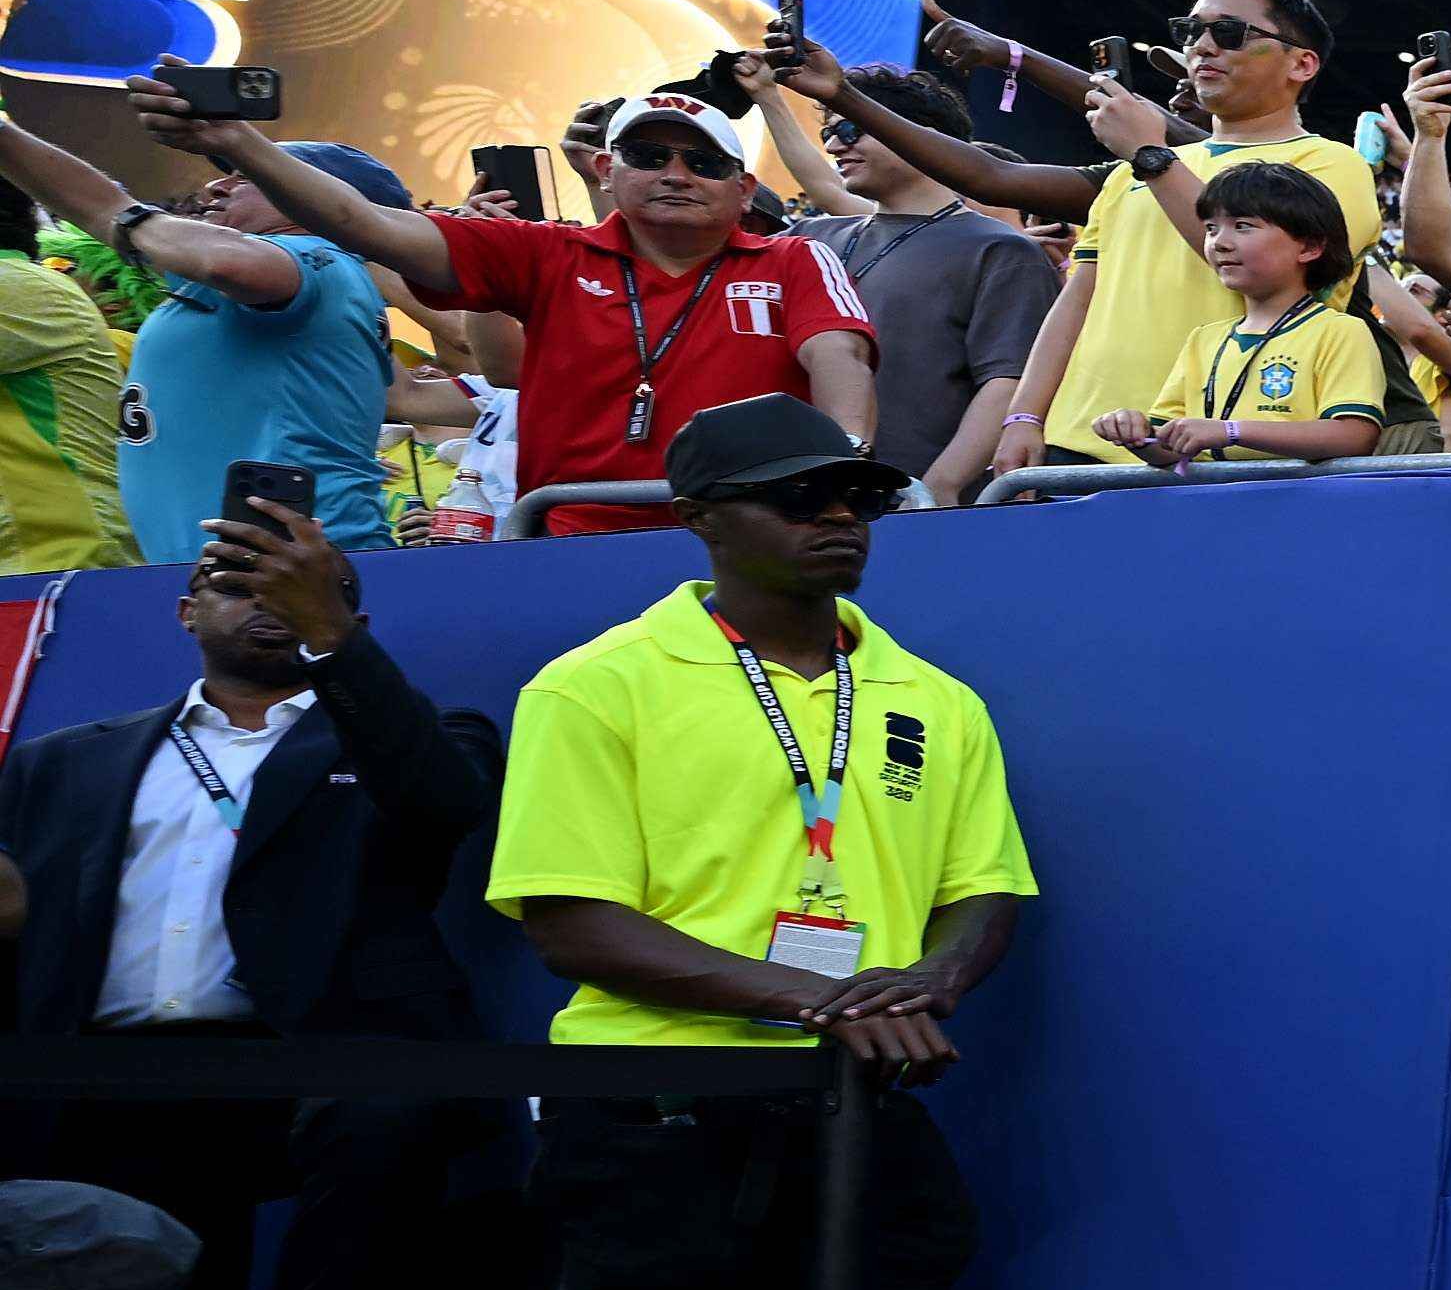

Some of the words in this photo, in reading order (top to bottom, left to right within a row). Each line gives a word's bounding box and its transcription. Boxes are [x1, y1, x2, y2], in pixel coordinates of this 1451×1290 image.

[732, 283, 784, 300] FPF
[755, 683, 776, 707] CUP
[837, 673, 852, 708] WORLD
[767, 706, 798, 750] WORLD
[837, 708, 851, 731] CUP
